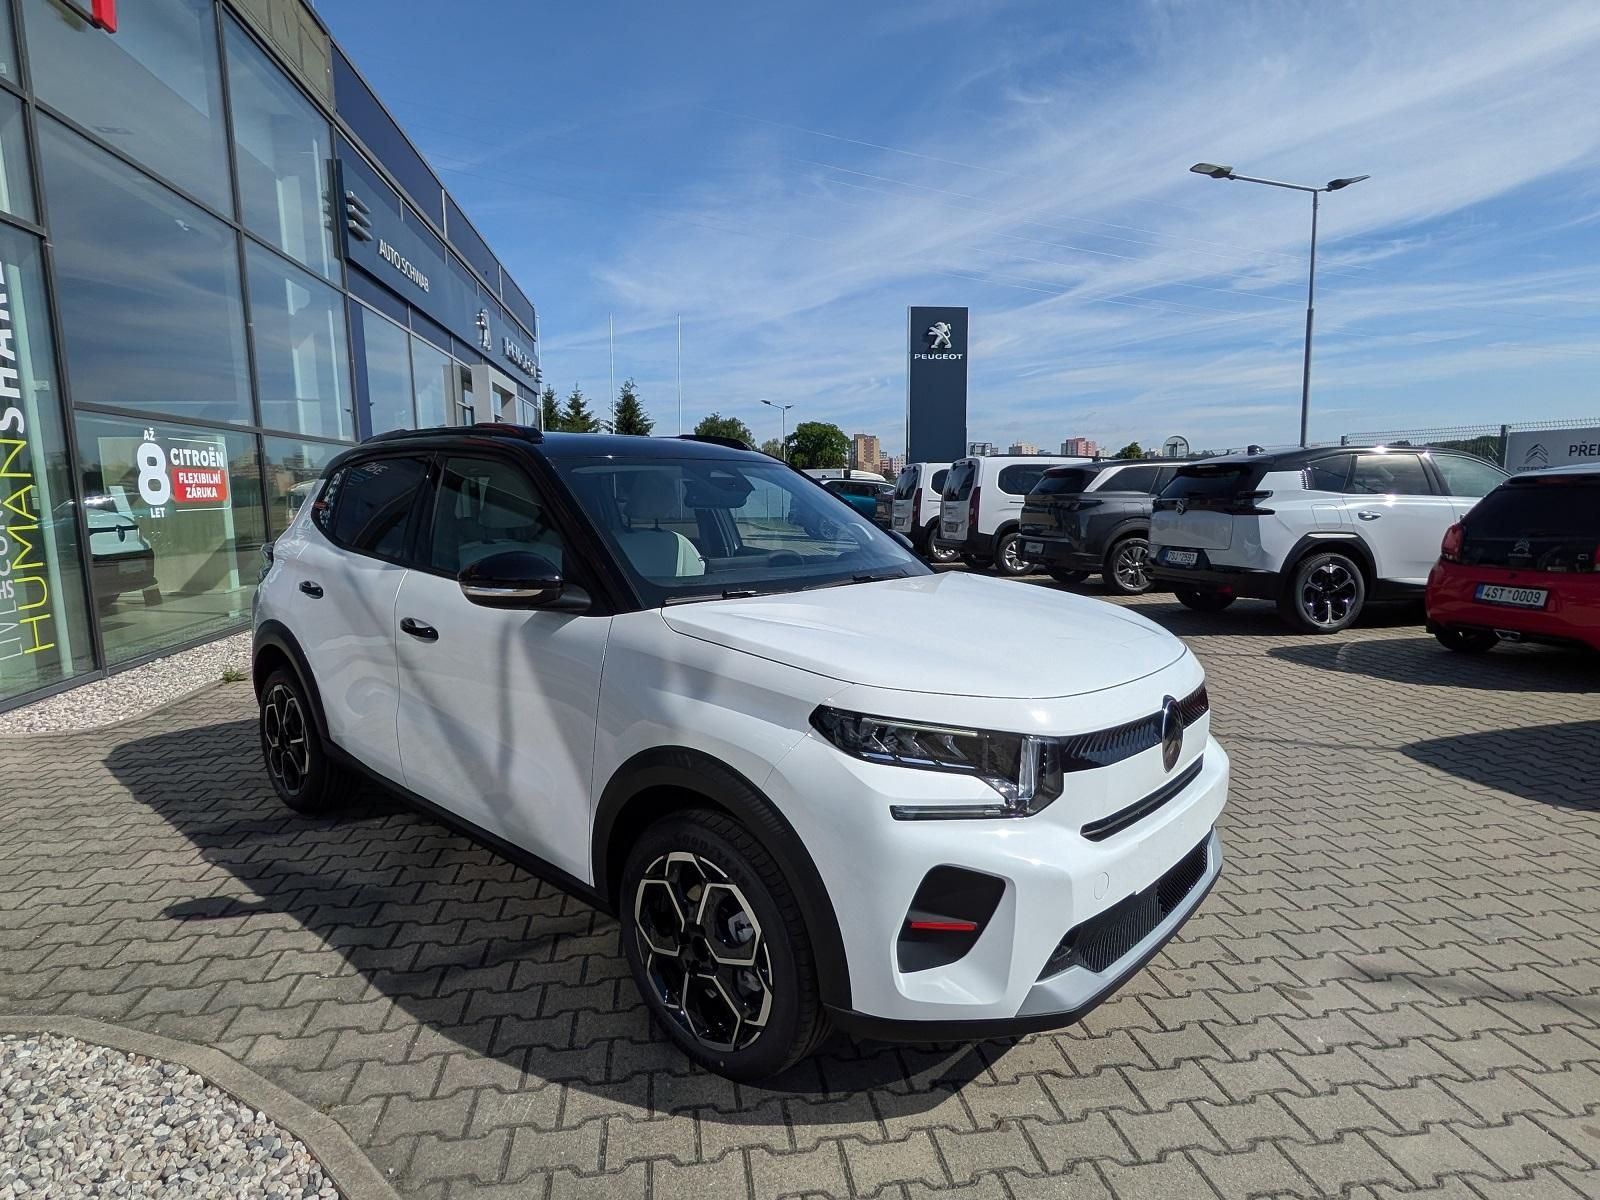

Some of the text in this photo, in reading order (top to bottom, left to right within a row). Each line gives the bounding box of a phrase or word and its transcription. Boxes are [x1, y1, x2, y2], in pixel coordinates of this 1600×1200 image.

[379, 239, 429, 292] AUTO SCHWAB
[143, 428, 155, 441] AŽ
[1568, 440, 1600, 457] PŘE
[170, 447, 224, 468] CITROËN
[137, 442, 171, 506] 8
[178, 469, 222, 485] FLEXIBILNÍ
[185, 484, 218, 499] ZÁRUKA
[150, 507, 166, 518] LET
[0, 438, 55, 654] HUMAN
[1484, 586, 1542, 603] 4ST 0009
